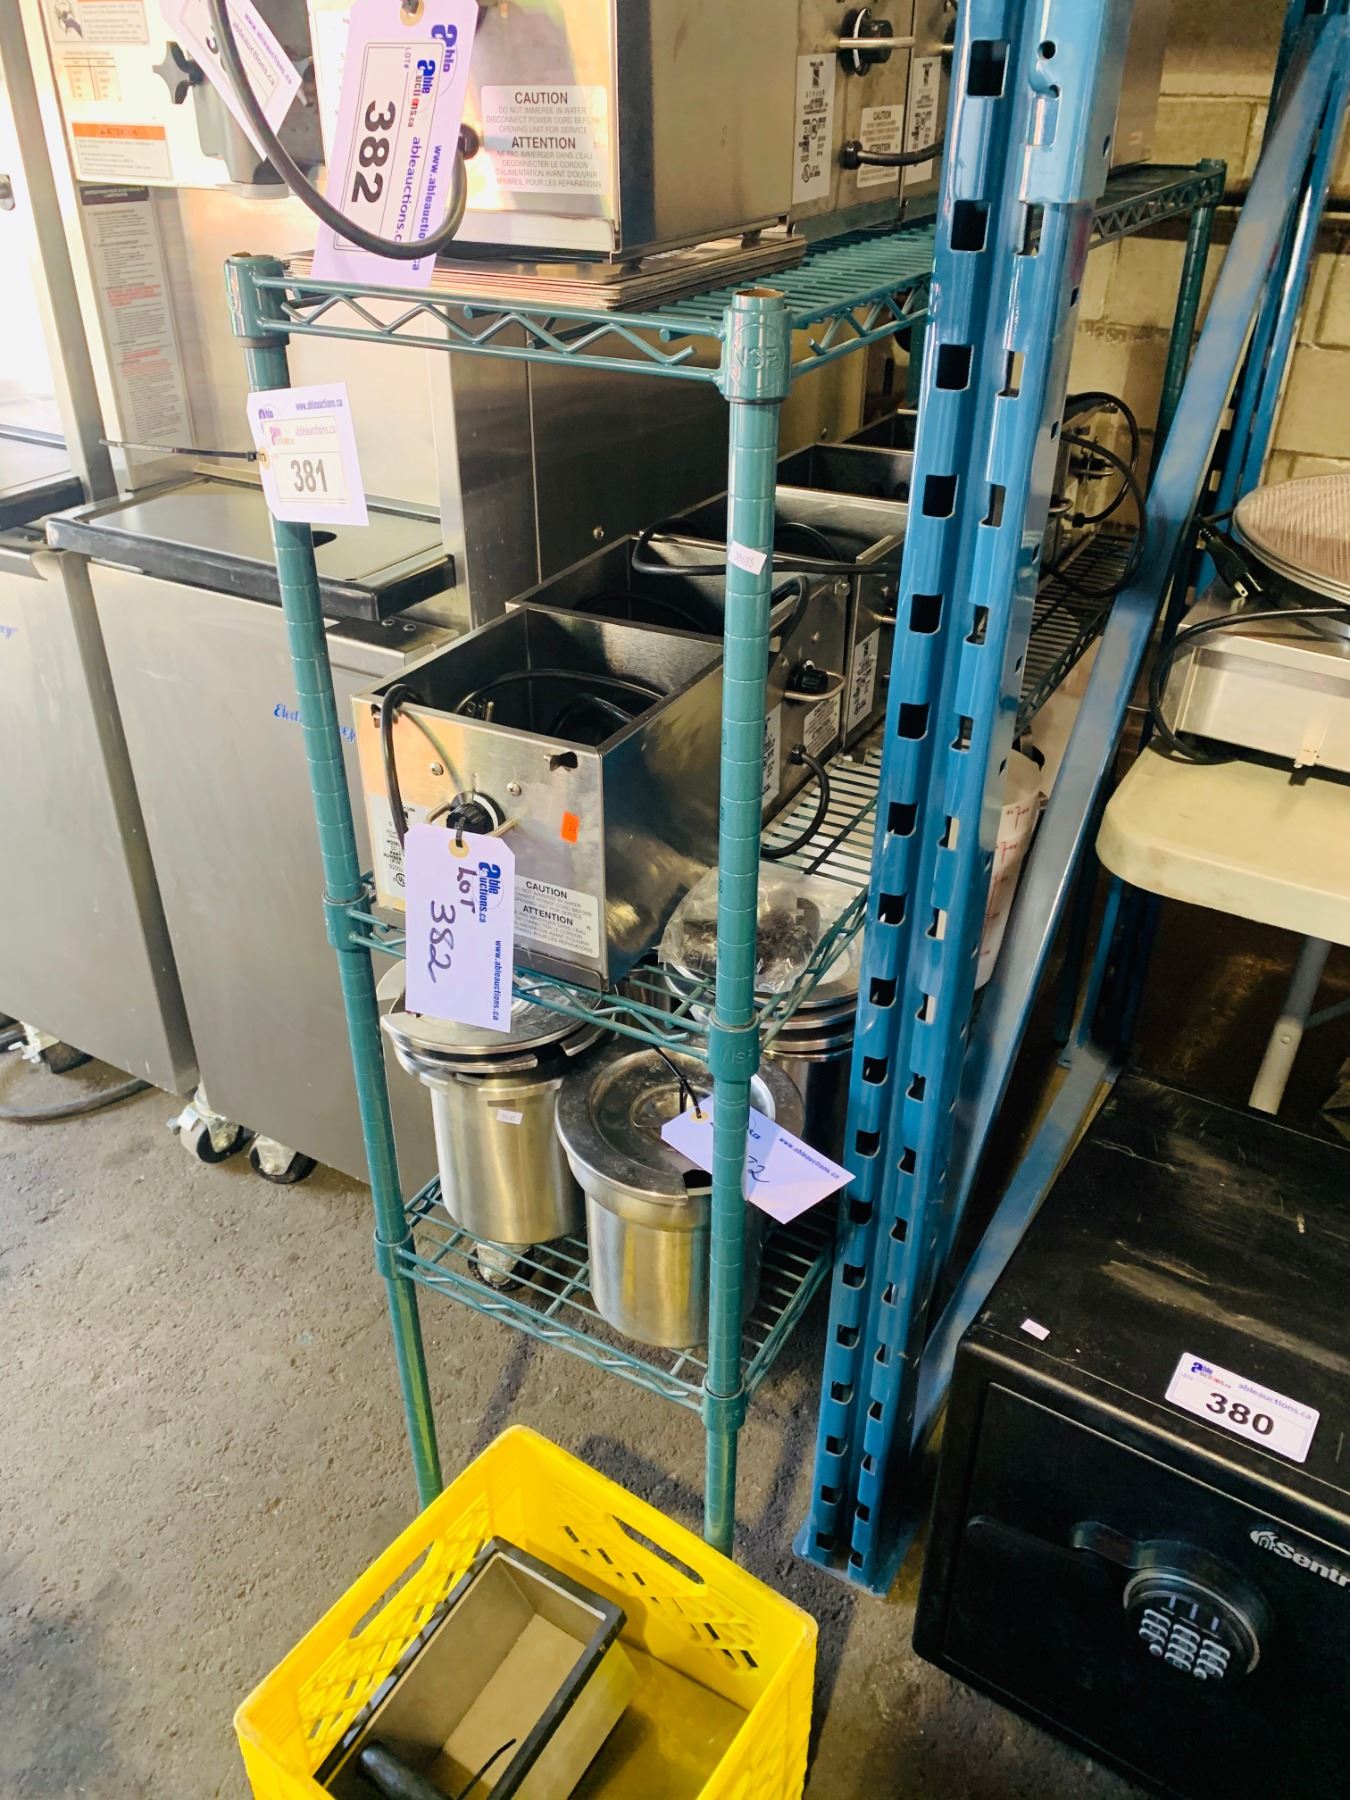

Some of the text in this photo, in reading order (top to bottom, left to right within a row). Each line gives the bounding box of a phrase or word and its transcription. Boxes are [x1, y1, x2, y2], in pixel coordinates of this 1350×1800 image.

[498, 106, 509, 114] DO
[510, 106, 523, 114] NOT
[514, 91, 568, 105] CAUTION
[351, 100, 396, 203] 382
[511, 136, 576, 149] ATTENTION
[394, 136, 422, 243] ableauctions.c
[290, 458, 328, 492] 381
[457, 866, 478, 914] LOT
[525, 881, 568, 899] CAUTION
[522, 904, 573, 926] ATTENTION
[428, 900, 456, 984] 382
[492, 940, 502, 1021] www.ableauctions.ca
[1205, 1392, 1275, 1435] 380
[1238, 1382, 1312, 1420] ableauctions.ca
[1273, 1542, 1350, 1593] Sentr
